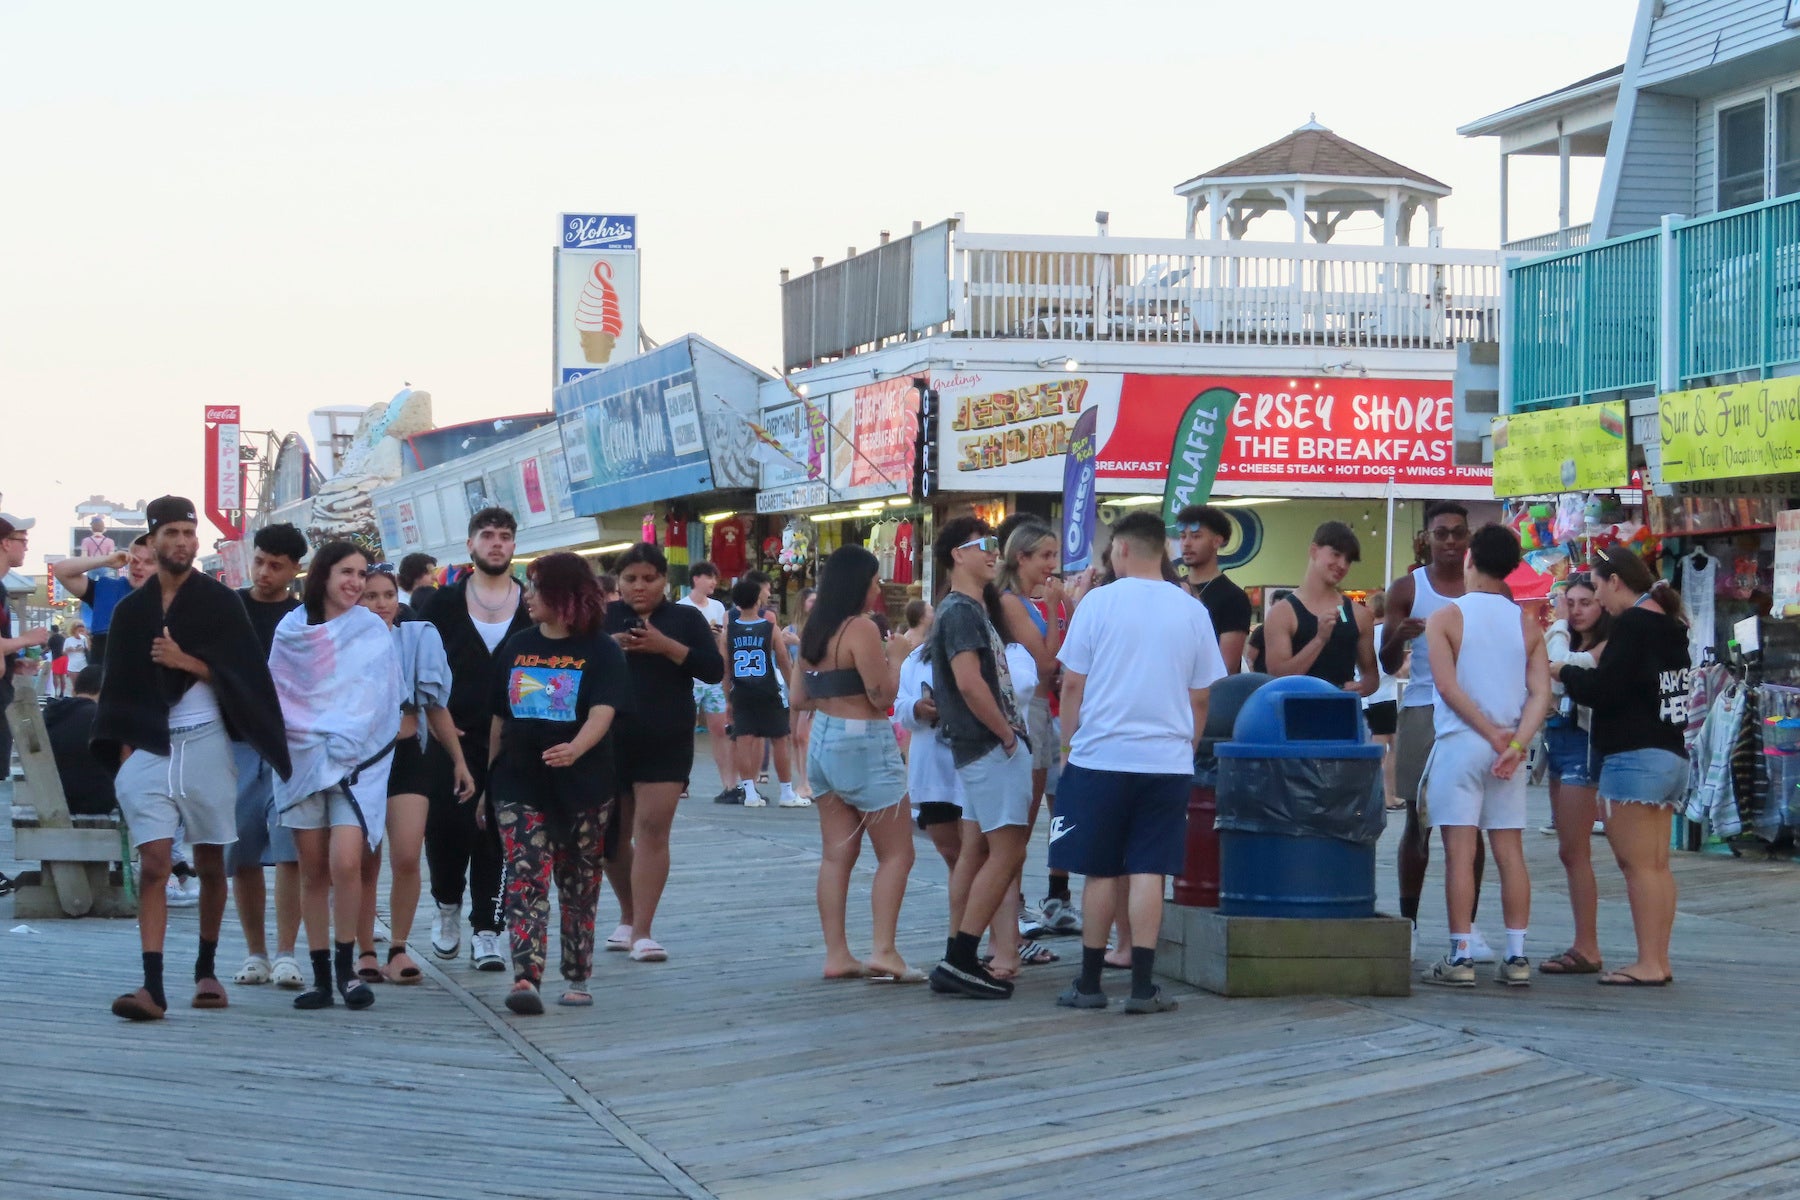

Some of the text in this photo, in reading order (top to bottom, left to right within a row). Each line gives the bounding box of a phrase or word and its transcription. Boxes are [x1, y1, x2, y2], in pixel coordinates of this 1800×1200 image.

[565, 217, 625, 242] Kohr's
[933, 374, 982, 392] Greetings
[952, 379, 1088, 431] JERSEY
[1232, 393, 1453, 433] ERSEY SHORE
[1661, 401, 1689, 445] Sun
[1694, 394, 1709, 437] &
[1716, 391, 1750, 438] Fun
[922, 389, 930, 498] GYRO
[957, 419, 1074, 471] SHORE
[1235, 436, 1289, 458] THE
[1700, 446, 1719, 468] Your
[1095, 461, 1163, 471] BREAKFAST
[1239, 463, 1284, 473] CHEESE
[1287, 464, 1326, 474] STEAK
[1335, 465, 1358, 475] HOT
[1362, 466, 1396, 476] DOGS
[1406, 467, 1446, 476] WINGS
[1456, 467, 1494, 477] FUNNE
[1171, 407, 1219, 515] FALAFEL
[222, 447, 236, 507] PIZZA
[1680, 482, 1714, 495] SUN
[1068, 465, 1092, 554] OREO
[733, 637, 765, 649] JORDAN
[514, 654, 586, 669] ハローキティ
[733, 649, 767, 678] 23
